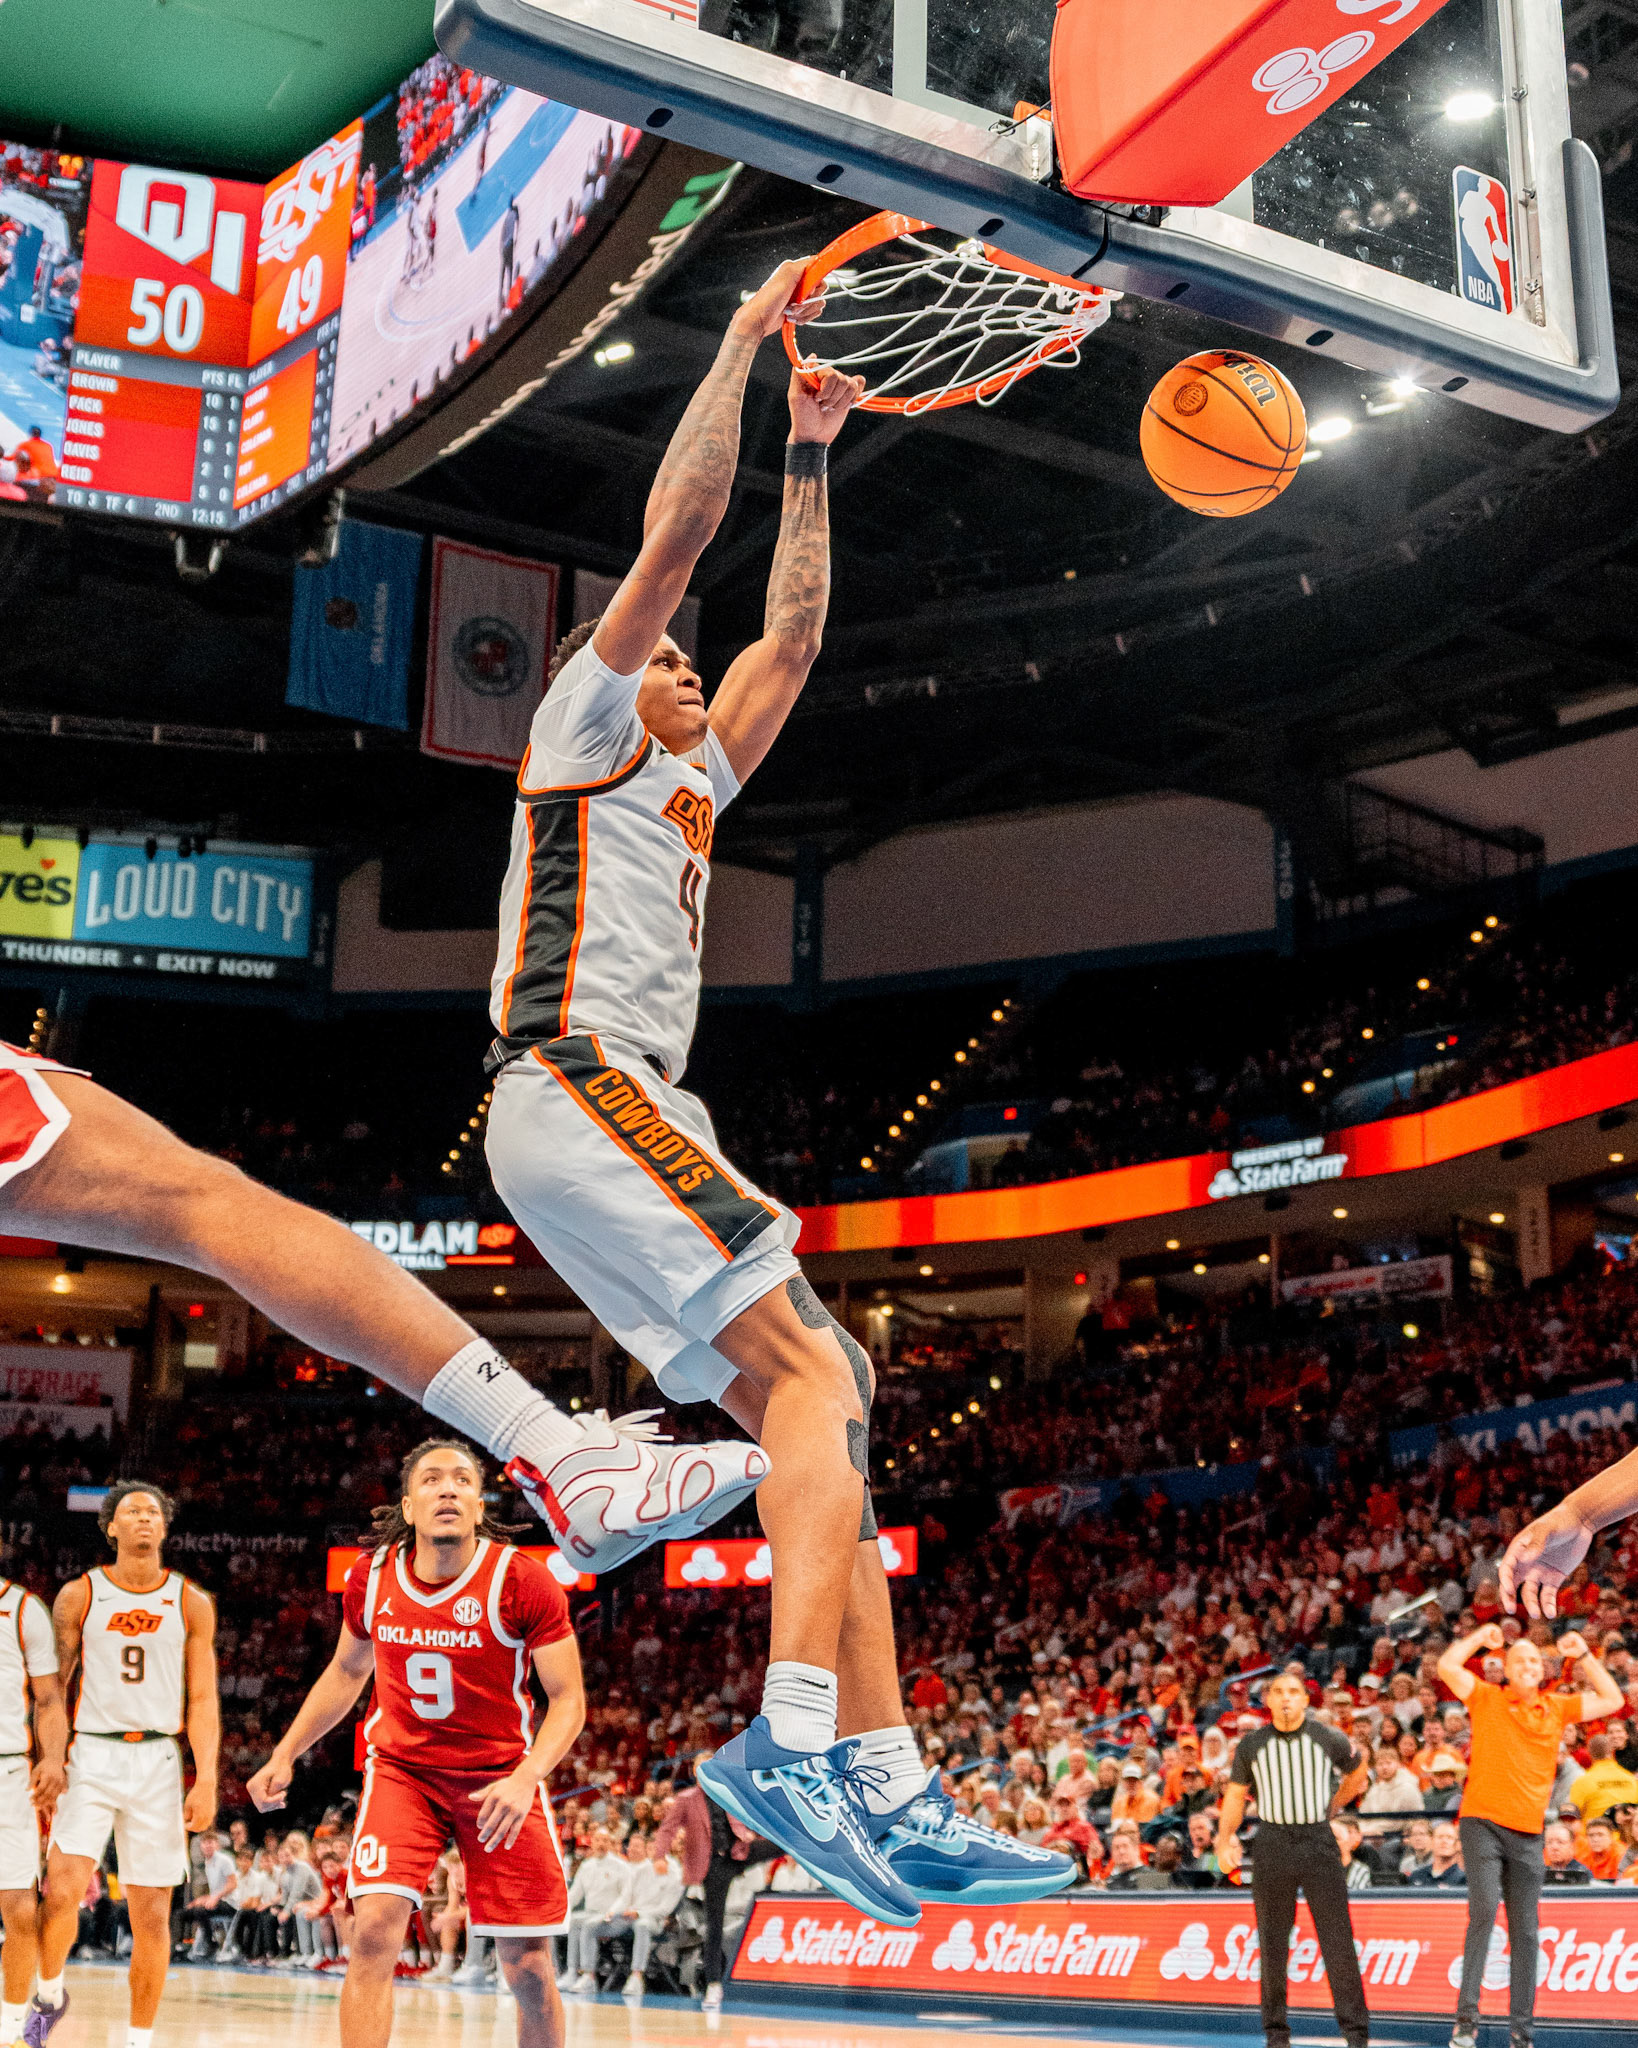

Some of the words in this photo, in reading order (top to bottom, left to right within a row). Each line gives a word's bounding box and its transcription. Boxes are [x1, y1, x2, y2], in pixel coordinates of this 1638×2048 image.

[277, 255, 322, 334] 49
[1467, 275, 1495, 306] NBA
[127, 278, 205, 353] 50
[76, 349, 121, 371] PLAYER
[201, 369, 225, 388] PTS
[227, 371, 245, 390] FL
[71, 371, 119, 395] BROWN
[230, 396, 240, 413] 1
[68, 394, 104, 416] PACK
[227, 418, 238, 435] 1
[65, 417, 105, 439] JONES
[225, 440, 235, 457] 1
[63, 440, 101, 462] DAVIS
[200, 461, 213, 478] 2
[60, 463, 93, 483] REID
[218, 486, 231, 503] 0
[67, 489, 85, 506] TO
[88, 492, 99, 509] 3
[106, 495, 122, 511] TF
[125, 498, 137, 514] 4
[154, 501, 181, 520] 2ND
[191, 507, 227, 526] 12:15
[85, 863, 197, 928] LOUD
[211, 865, 302, 942] CITY
[679, 858, 703, 952] 4
[1, 941, 120, 967] THUNDER
[156, 953, 212, 975] EXIT
[217, 957, 277, 980] NOW
[584, 1067, 714, 1193] COWBOYS
[105, 1609, 164, 1637] OSU
[453, 1597, 482, 1627] SEC
[377, 1625, 483, 1648] OKLAHOMA
[121, 1645, 146, 1684] 9
[405, 1652, 454, 1720] 9
[355, 1835, 388, 1878] OU
